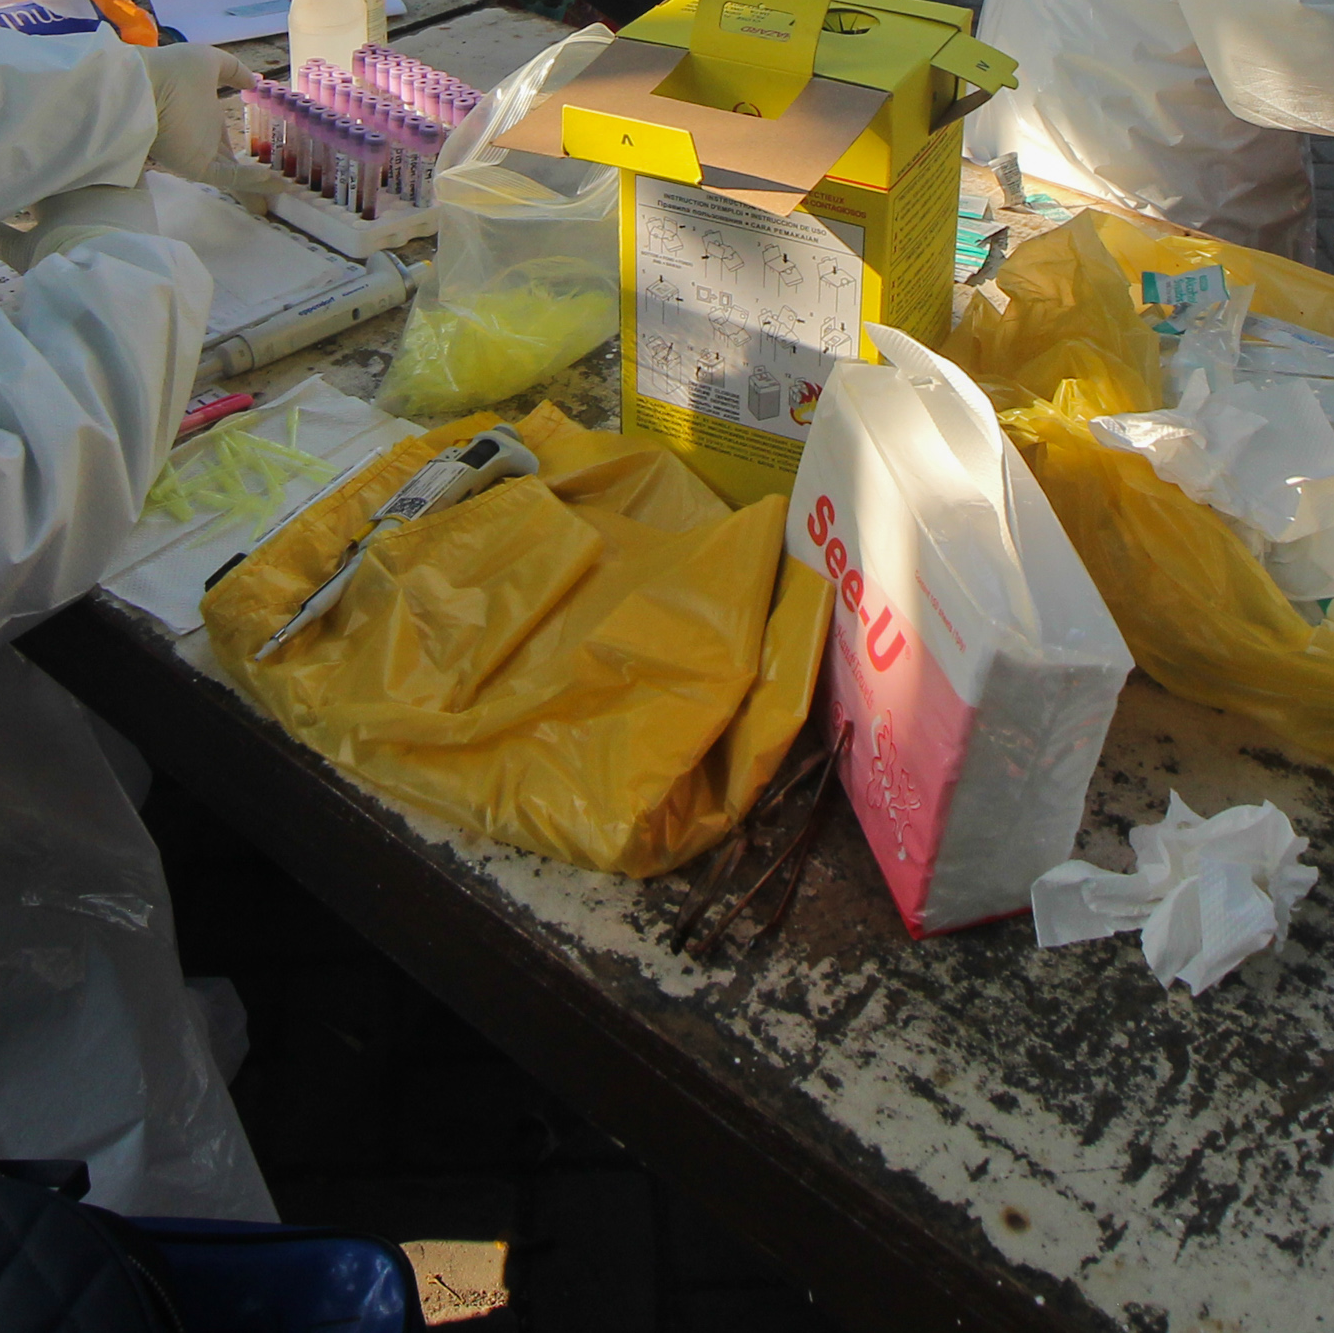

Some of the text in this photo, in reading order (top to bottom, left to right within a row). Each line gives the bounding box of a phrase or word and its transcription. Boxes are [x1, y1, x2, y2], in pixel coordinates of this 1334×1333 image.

[657, 199, 690, 214] Правила
[810, 192, 845, 205] ECTIEUX
[810, 200, 867, 219] CONTAGIOSOS
[664, 193, 710, 209] INSTRUCTION
[750, 213, 799, 230] INSTRUCCION
[799, 223, 811, 232] DE
[811, 225, 828, 236] USO
[750, 221, 820, 244] CARA PEMAKAIAN
[297, 295, 336, 317] eppendorf
[807, 494, 907, 673] See-U
